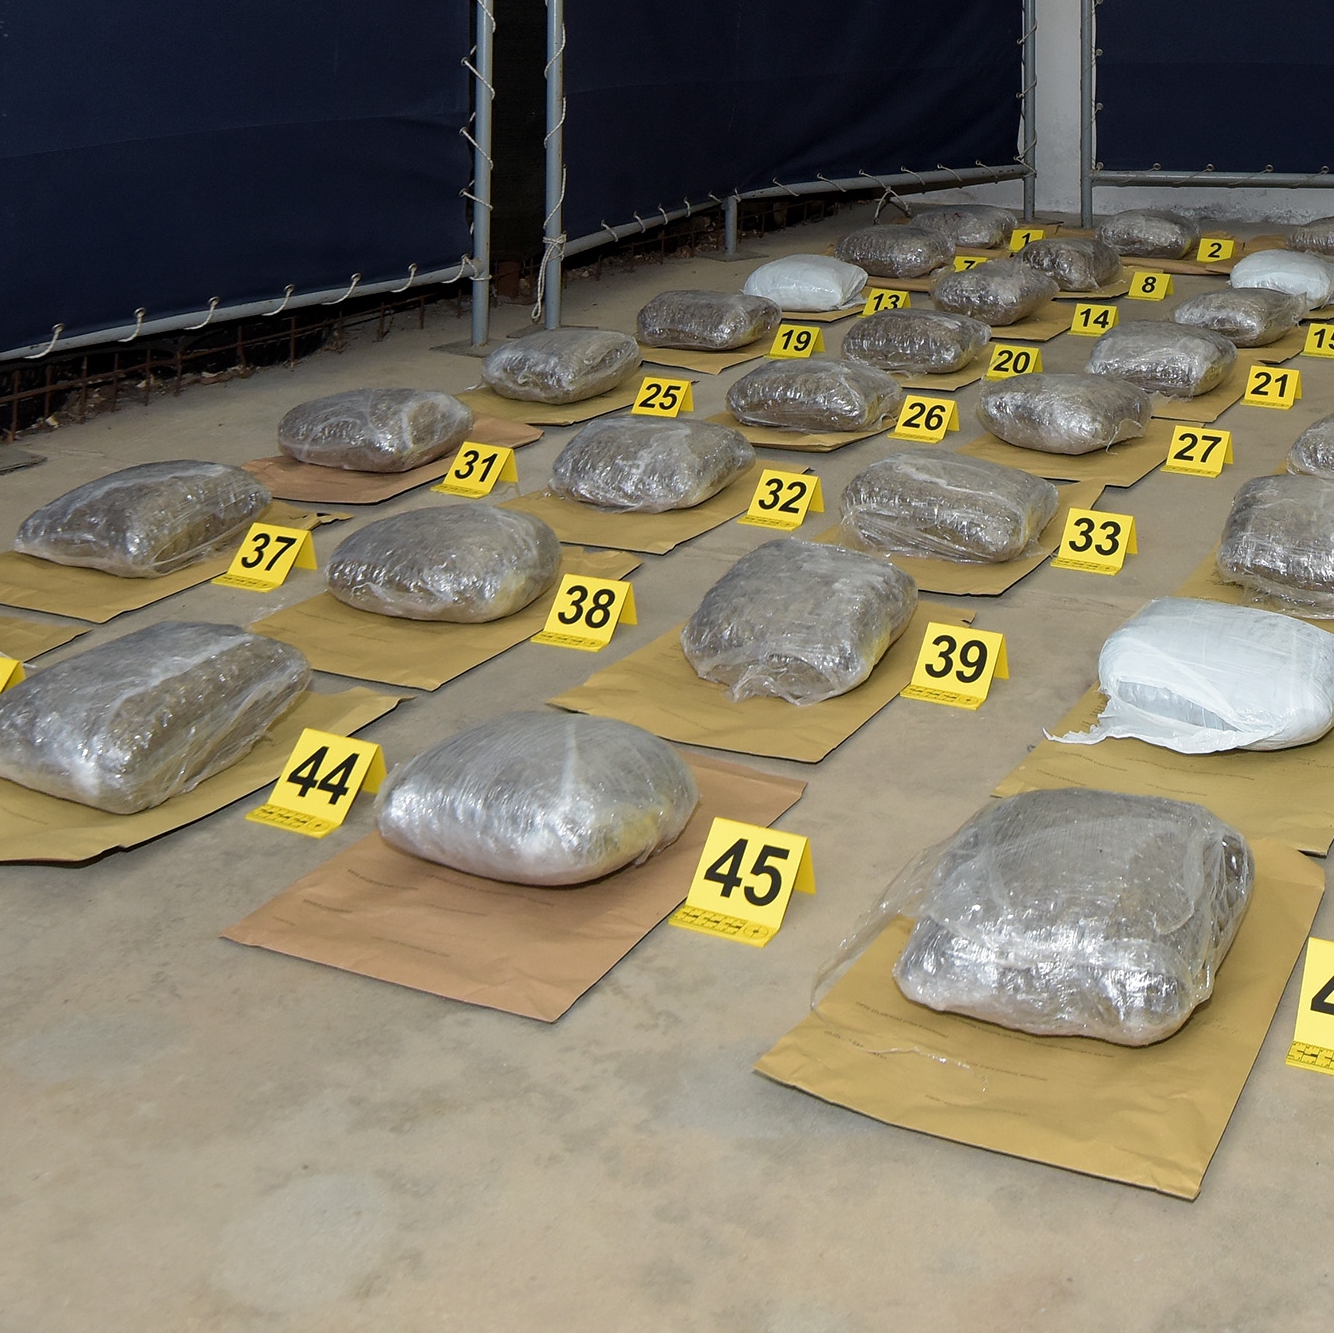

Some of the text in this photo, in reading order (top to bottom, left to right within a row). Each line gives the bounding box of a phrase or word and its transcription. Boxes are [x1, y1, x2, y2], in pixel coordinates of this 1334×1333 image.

[1022, 233, 1031, 246] 1
[1208, 243, 1222, 258] 2
[1142, 277, 1156, 293] 8
[873, 293, 899, 311] 13
[1081, 309, 1109, 328] 14
[782, 330, 811, 351] 19
[994, 350, 1030, 373] 20
[639, 384, 681, 410] 25
[1251, 372, 1287, 397] 21
[903, 403, 945, 430] 26
[1174, 433, 1221, 462] 27
[455, 451, 497, 482] 31
[759, 479, 806, 513] 32
[1069, 518, 1120, 555] 33
[242, 533, 296, 570] 37
[558, 586, 615, 628] 38
[926, 635, 987, 683] 39
[287, 747, 359, 804] 44
[705, 839, 789, 906] 45
